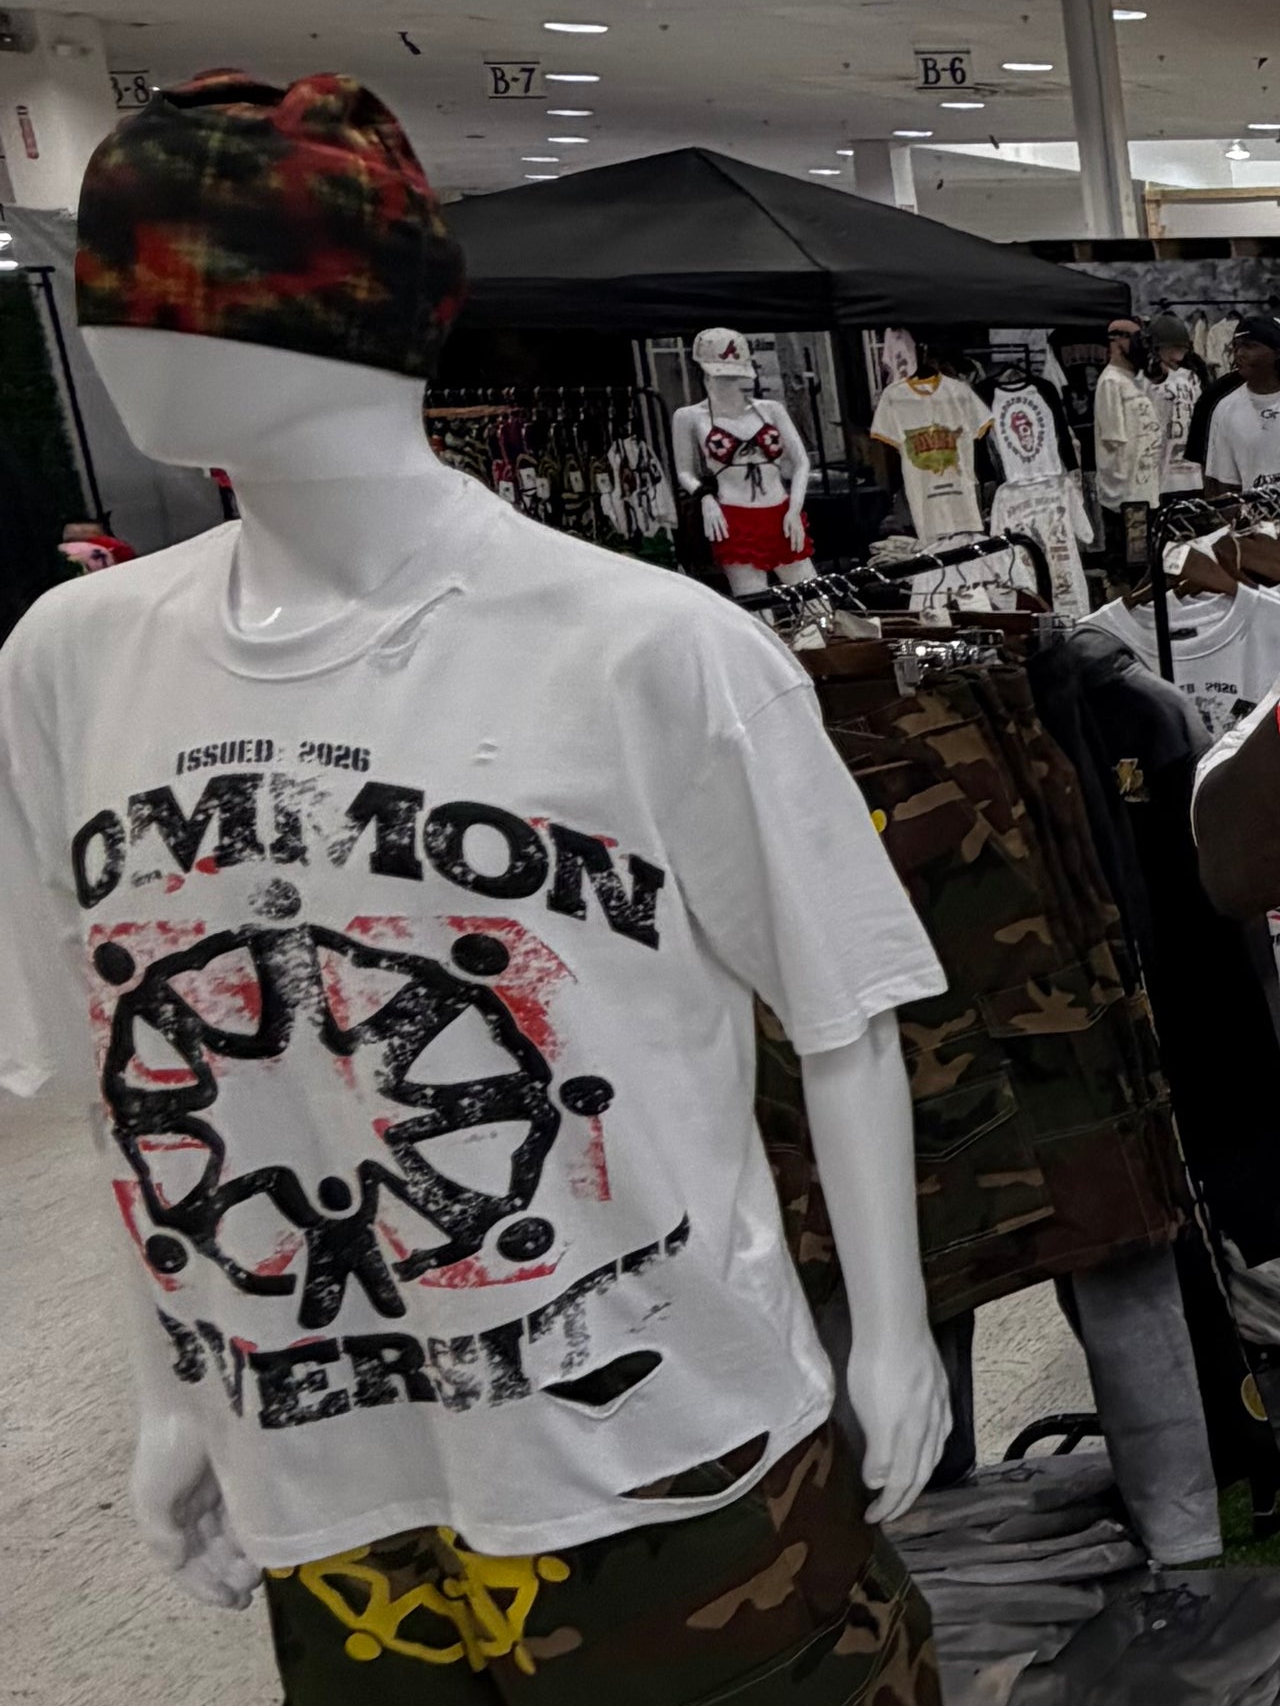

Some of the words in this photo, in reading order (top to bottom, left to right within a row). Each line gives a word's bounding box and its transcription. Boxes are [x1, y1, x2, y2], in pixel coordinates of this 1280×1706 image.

[490, 66, 535, 95] B-7
[919, 55, 967, 86] B-6
[298, 741, 371, 772] 2026
